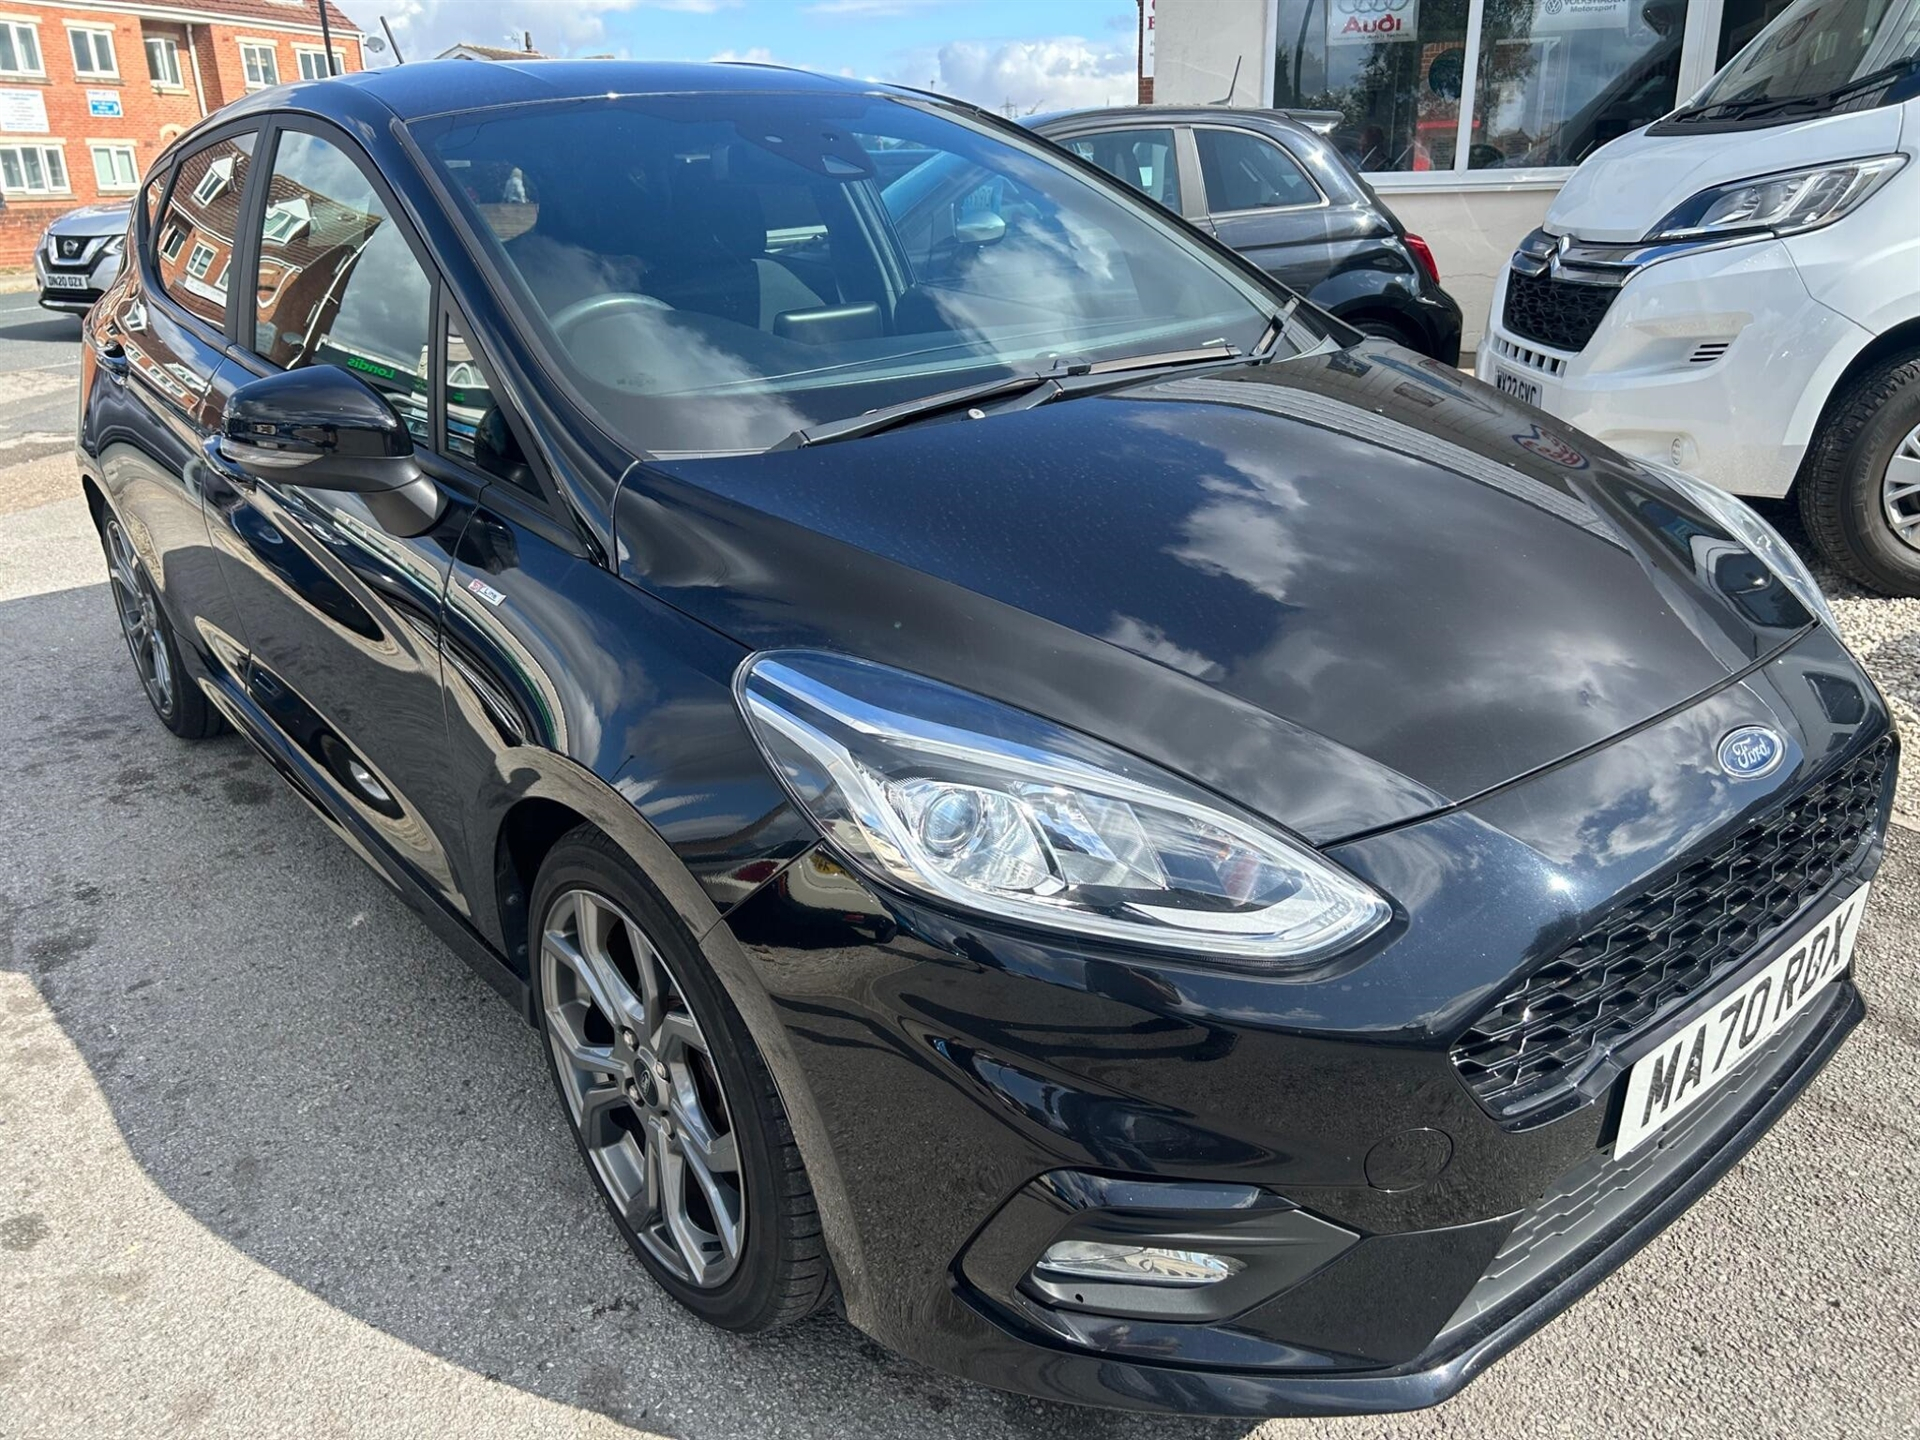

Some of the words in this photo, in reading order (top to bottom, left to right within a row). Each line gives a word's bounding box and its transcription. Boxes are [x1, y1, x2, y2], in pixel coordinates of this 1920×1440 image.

[1570, 5, 1616, 13] Motorsport
[1341, 14, 1401, 34] Audi
[1732, 737, 1770, 768] Ford
[1640, 975, 1773, 1128] MA70
